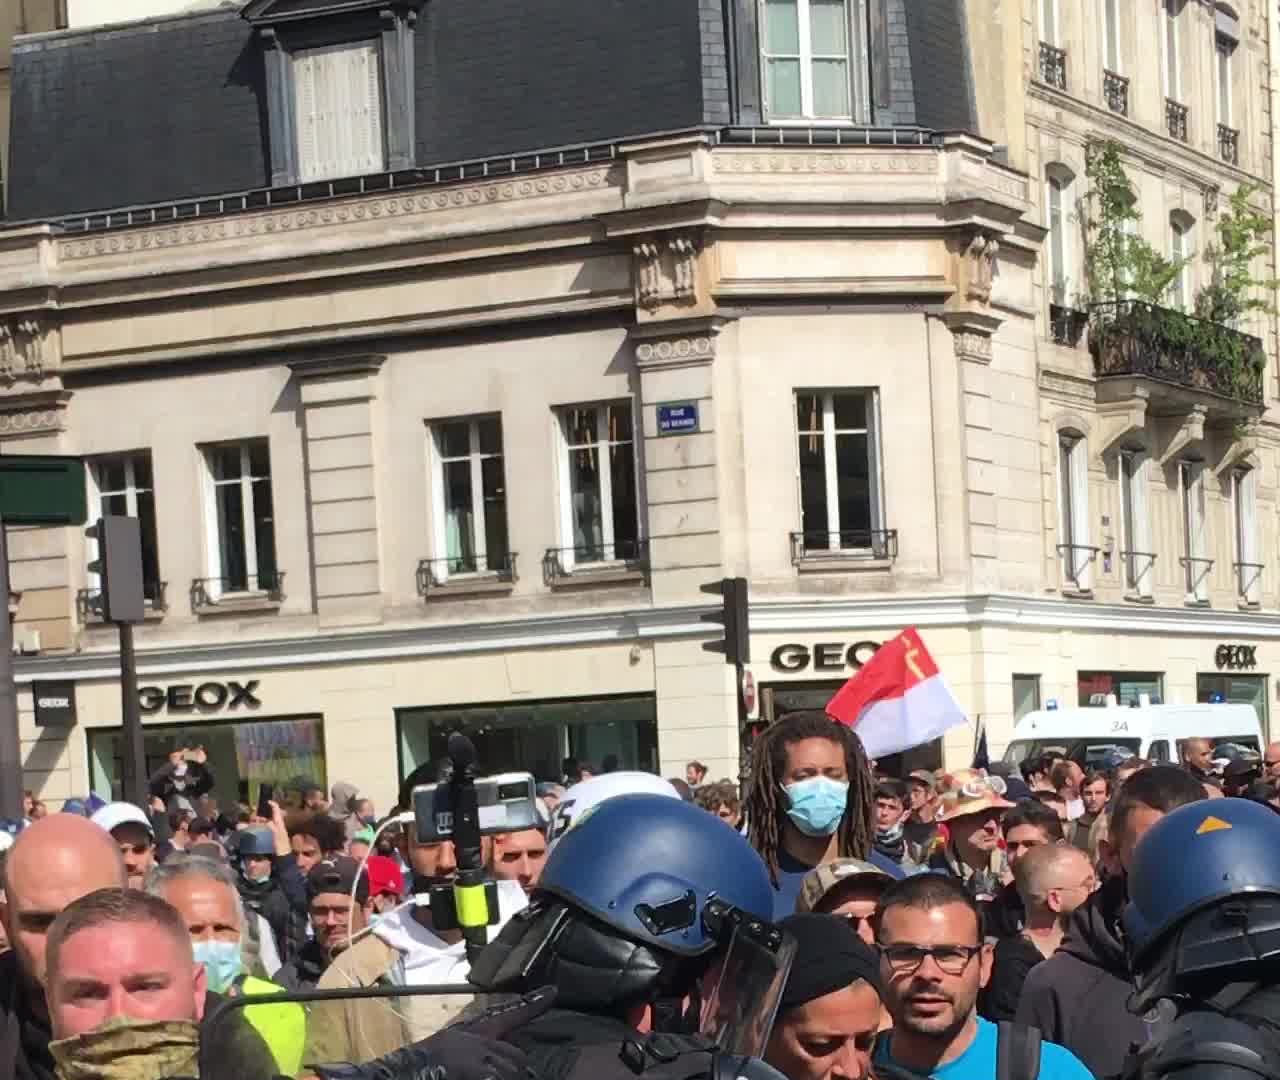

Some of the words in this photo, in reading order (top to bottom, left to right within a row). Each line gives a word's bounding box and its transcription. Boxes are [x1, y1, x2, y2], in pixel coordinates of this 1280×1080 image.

[771, 641, 881, 674] GEO
[1214, 643, 1258, 670] GEOX
[37, 697, 70, 709] GEOX
[137, 680, 262, 715] GEOX
